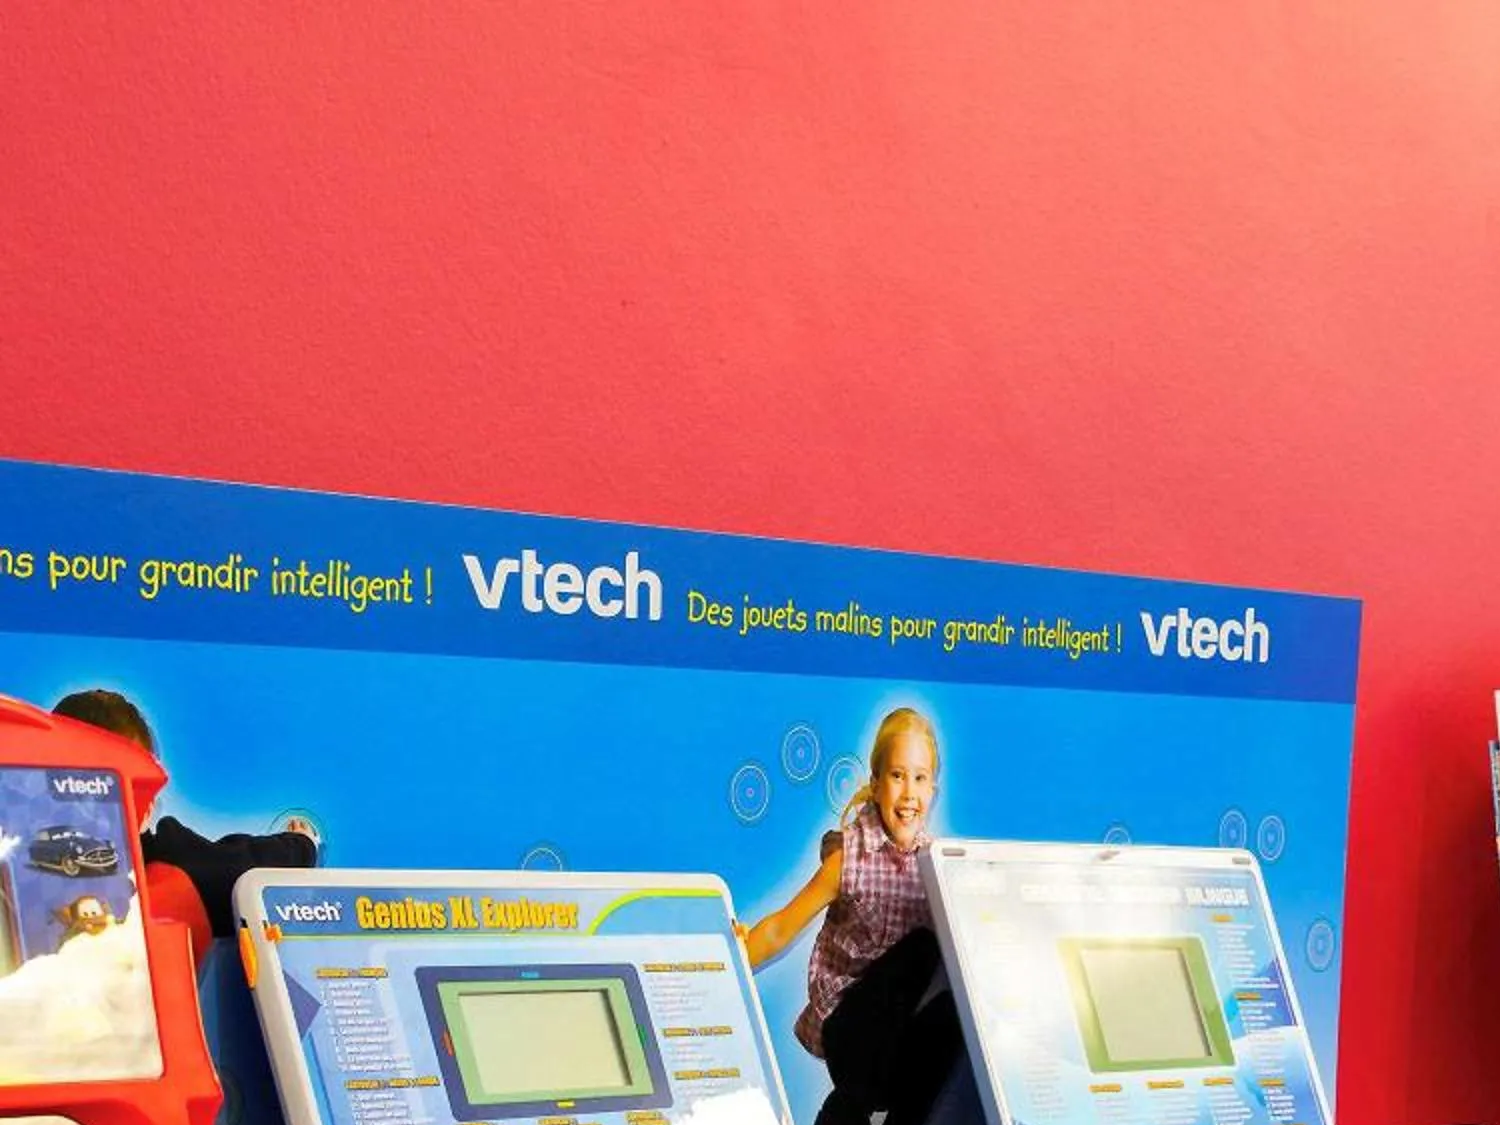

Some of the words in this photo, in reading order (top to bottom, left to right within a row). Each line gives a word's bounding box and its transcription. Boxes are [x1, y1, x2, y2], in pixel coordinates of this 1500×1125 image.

[49, 551, 126, 589] pour
[140, 554, 258, 599] grandir
[272, 557, 413, 613] intelligent
[424, 567, 433, 605] !
[463, 549, 663, 621] vtech
[688, 592, 733, 626] Des
[740, 595, 807, 634] jouets
[816, 602, 882, 638] malins
[891, 614, 936, 641] pour
[943, 615, 1016, 652] grandir
[1022, 617, 1110, 659] intelligent
[1140, 606, 1270, 664] vtech
[355, 895, 448, 930] Genius
[450, 896, 477, 929] XL
[480, 896, 579, 932] Explorer
